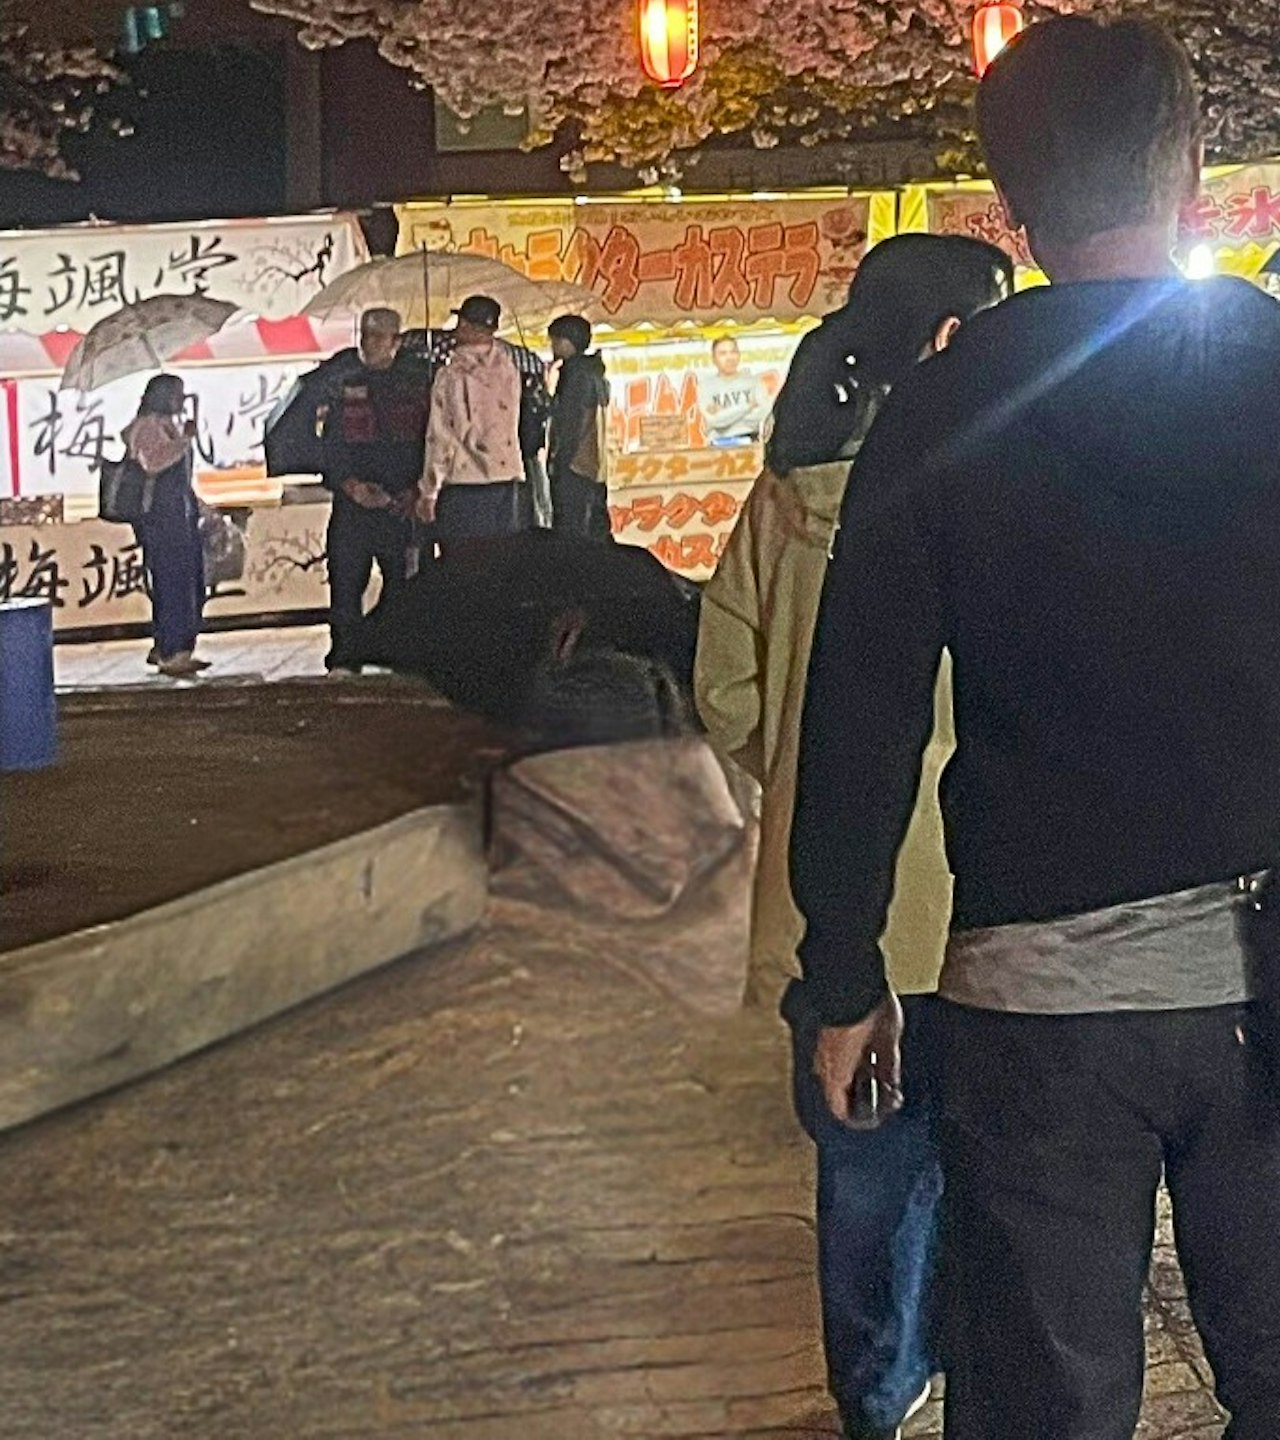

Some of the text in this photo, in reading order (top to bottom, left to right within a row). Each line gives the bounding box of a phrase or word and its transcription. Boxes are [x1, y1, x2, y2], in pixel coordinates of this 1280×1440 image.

[710, 388, 751, 410] NAVY
[648, 531, 730, 570] カス
[0, 538, 246, 608] 梅颯
